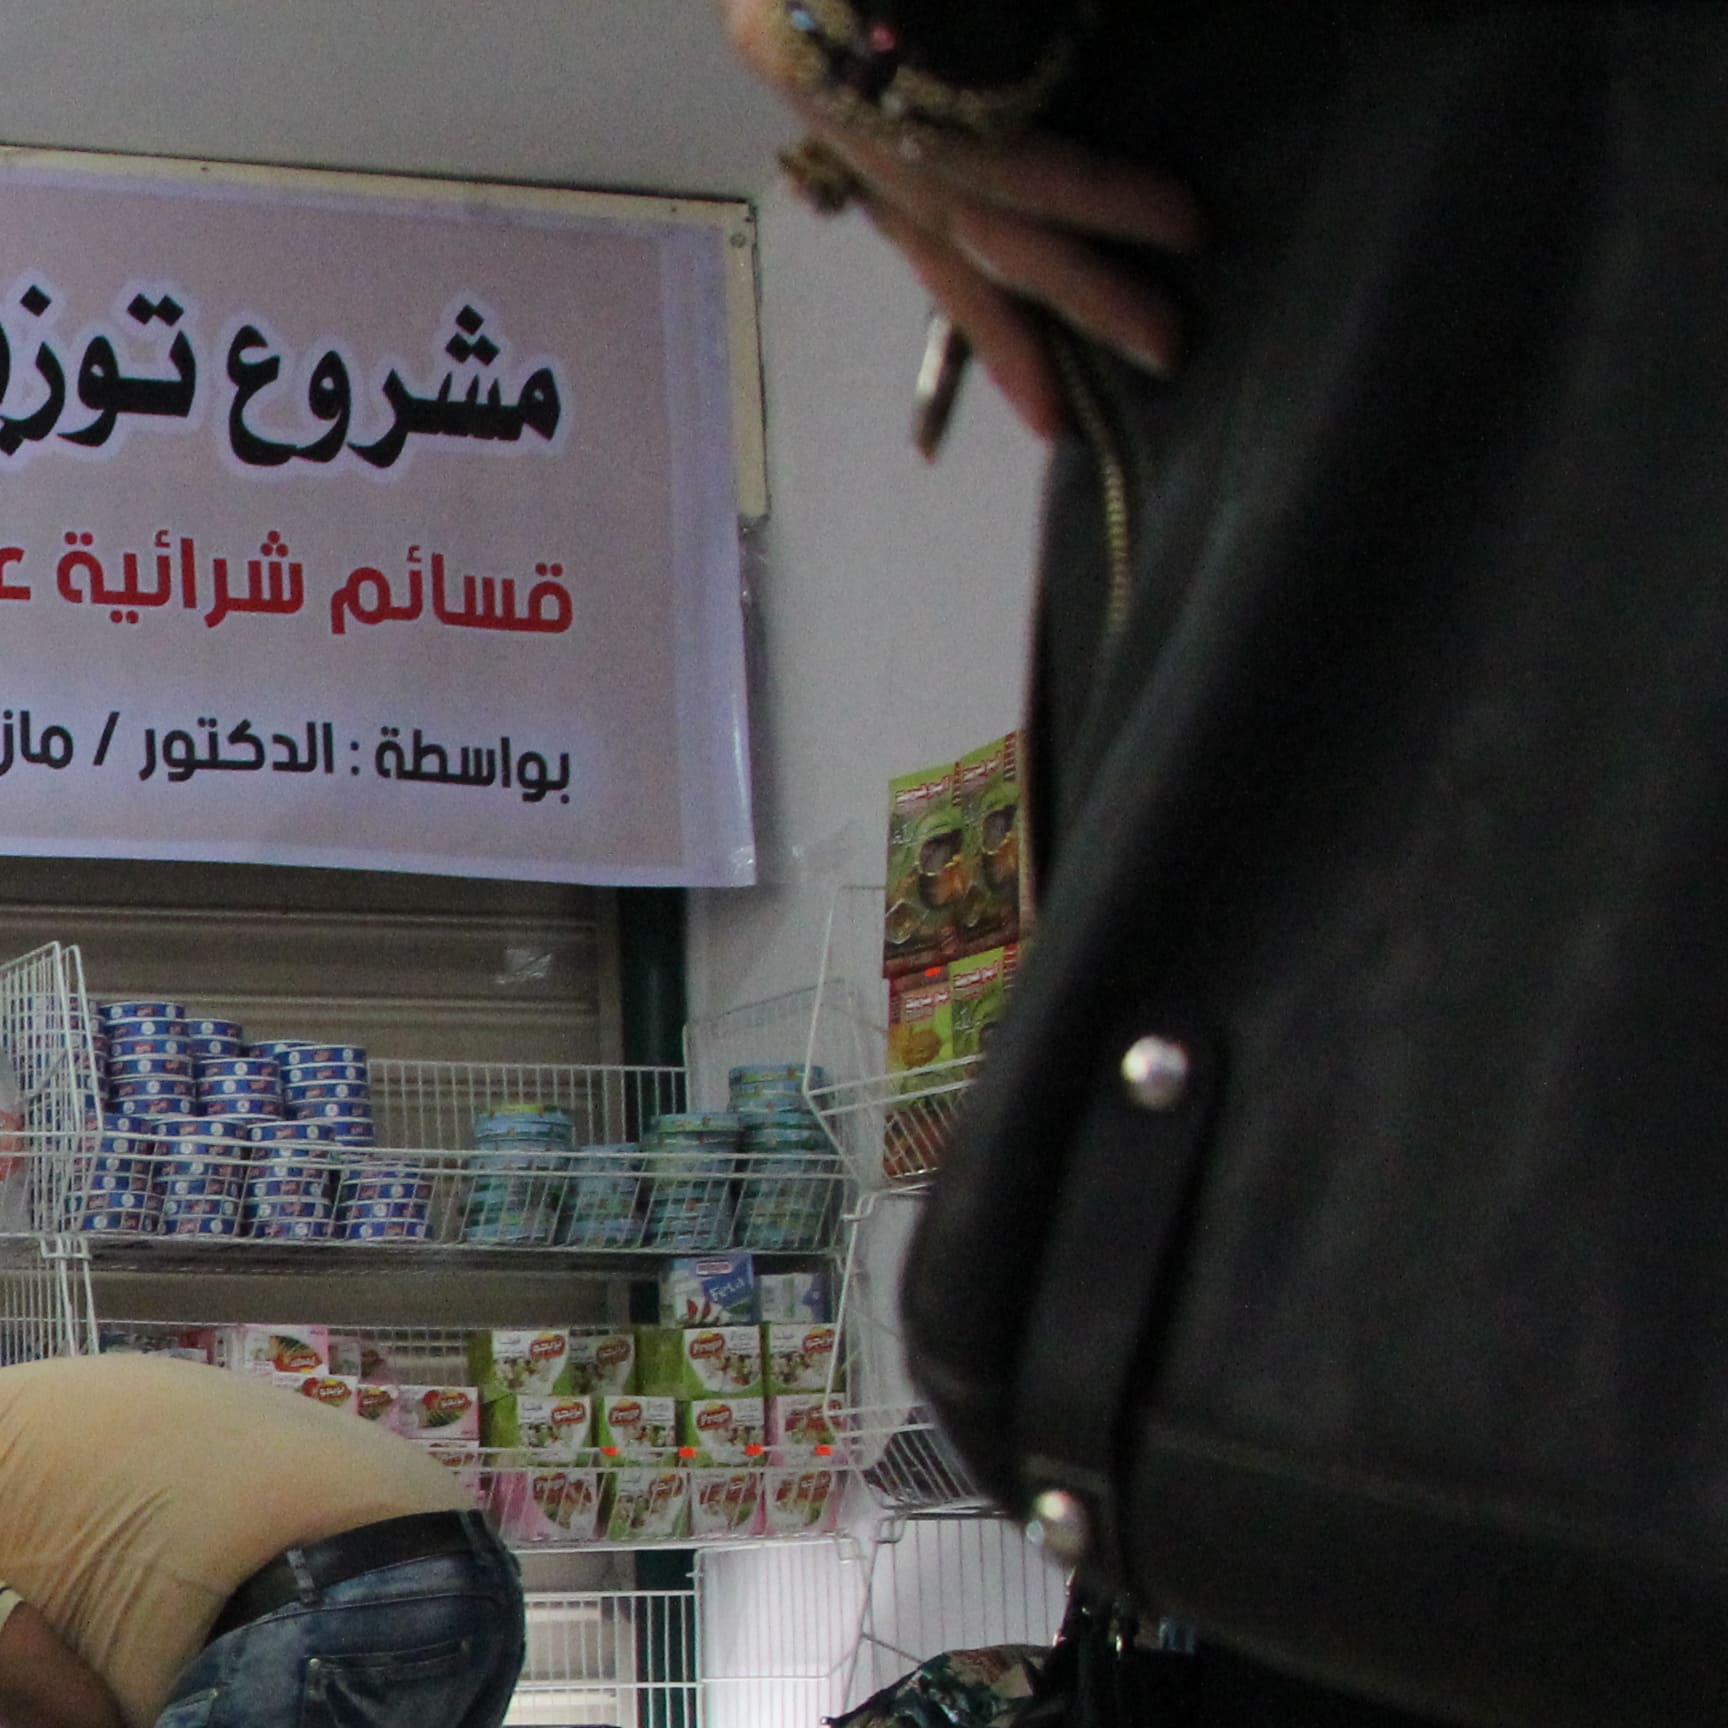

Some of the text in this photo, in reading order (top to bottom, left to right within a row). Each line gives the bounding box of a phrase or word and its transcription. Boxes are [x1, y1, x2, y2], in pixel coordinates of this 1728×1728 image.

[226, 304, 562, 469] مشروع
[55, 528, 305, 628] شرائية
[330, 545, 574, 635] قسائم
[139, 716, 334, 783] الدكتور
[375, 725, 571, 804] بواسطة
